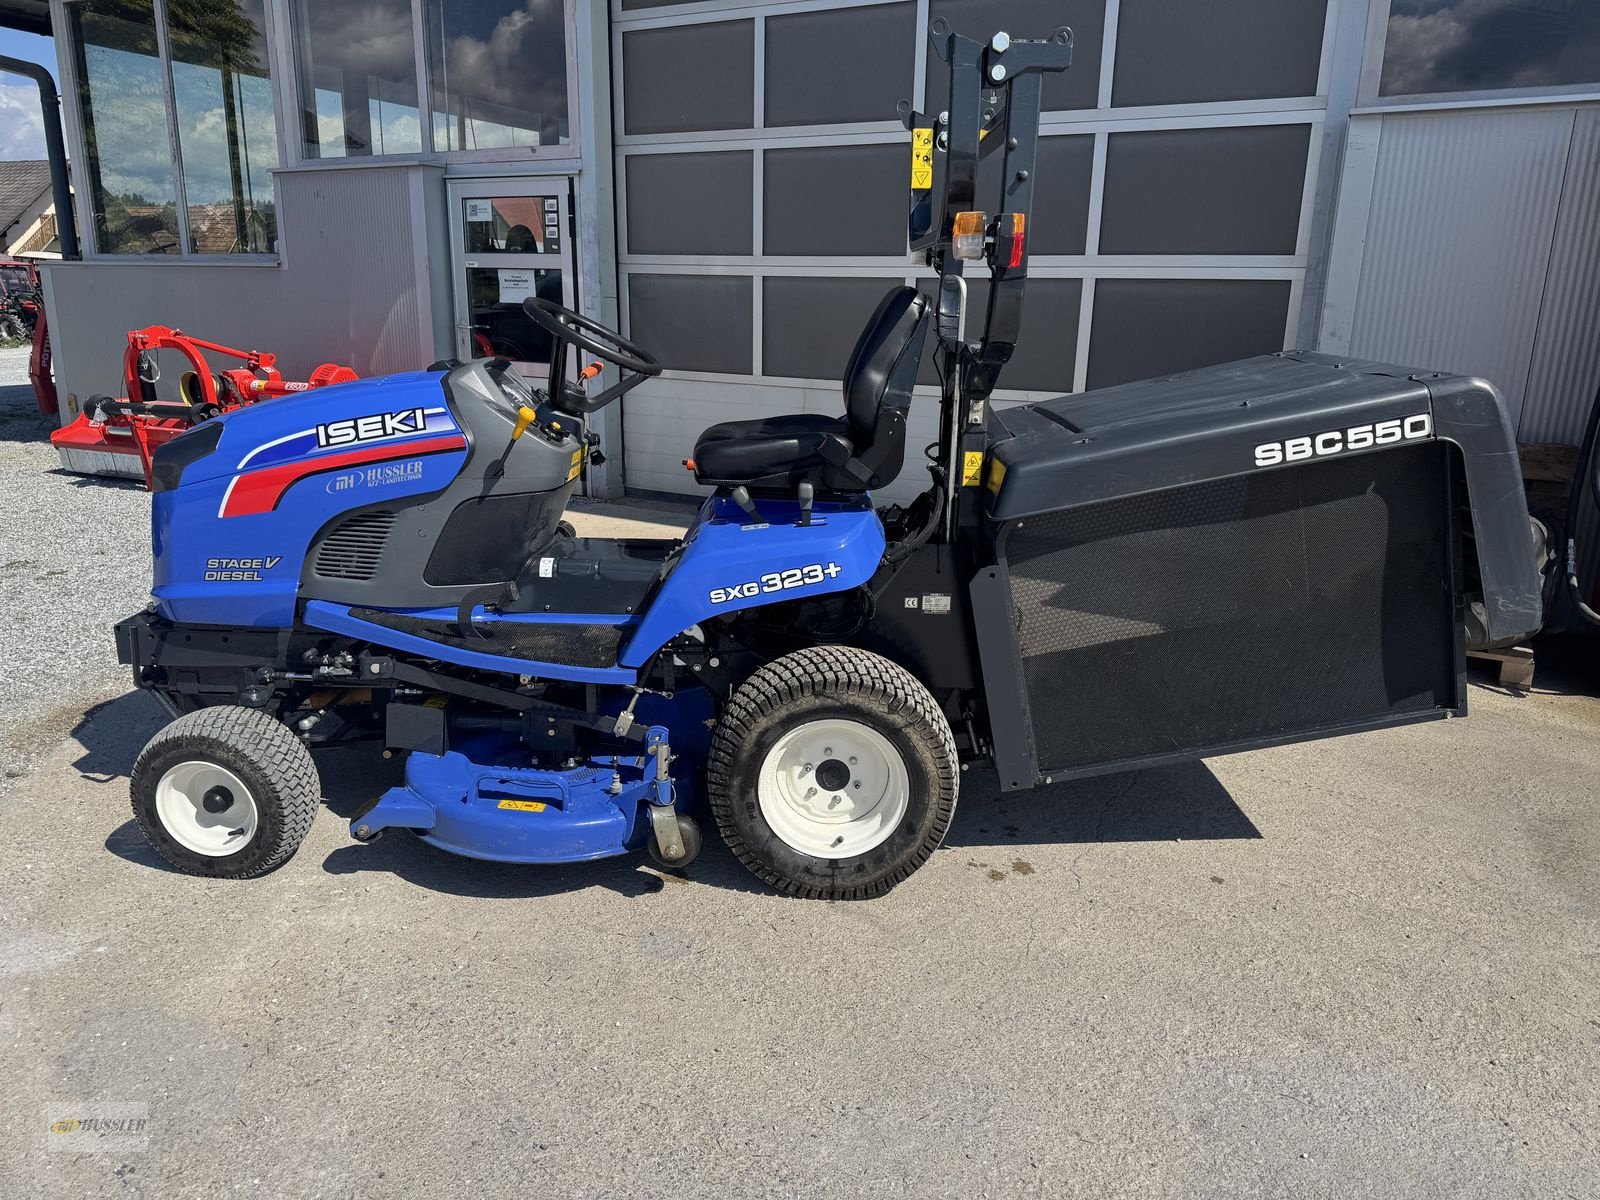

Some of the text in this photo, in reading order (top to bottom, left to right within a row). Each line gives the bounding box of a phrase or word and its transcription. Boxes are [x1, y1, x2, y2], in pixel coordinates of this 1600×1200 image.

[317, 408, 425, 447] ISEKI
[367, 461, 423, 481] HUSSLER
[207, 556, 281, 569] STAGE V
[204, 571, 263, 581] DIESEL
